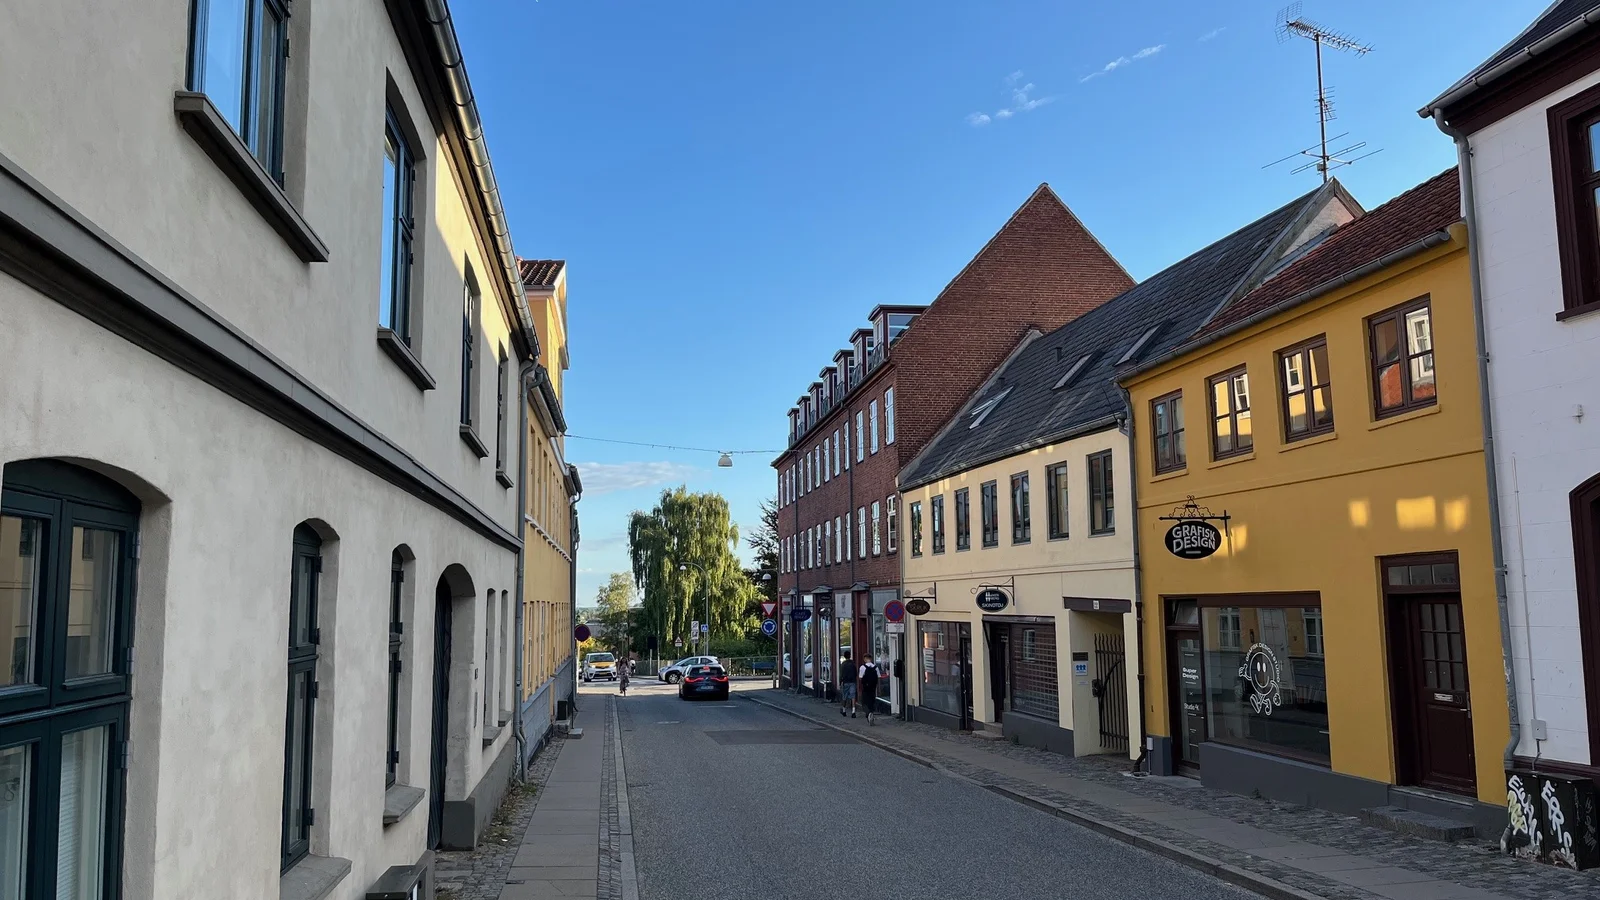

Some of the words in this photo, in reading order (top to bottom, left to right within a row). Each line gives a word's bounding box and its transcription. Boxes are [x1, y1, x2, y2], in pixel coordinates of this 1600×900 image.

[1172, 525, 1215, 540] GRAFISK
[1173, 536, 1215, 553] DESIGN
[1182, 672, 1199, 680] Design
